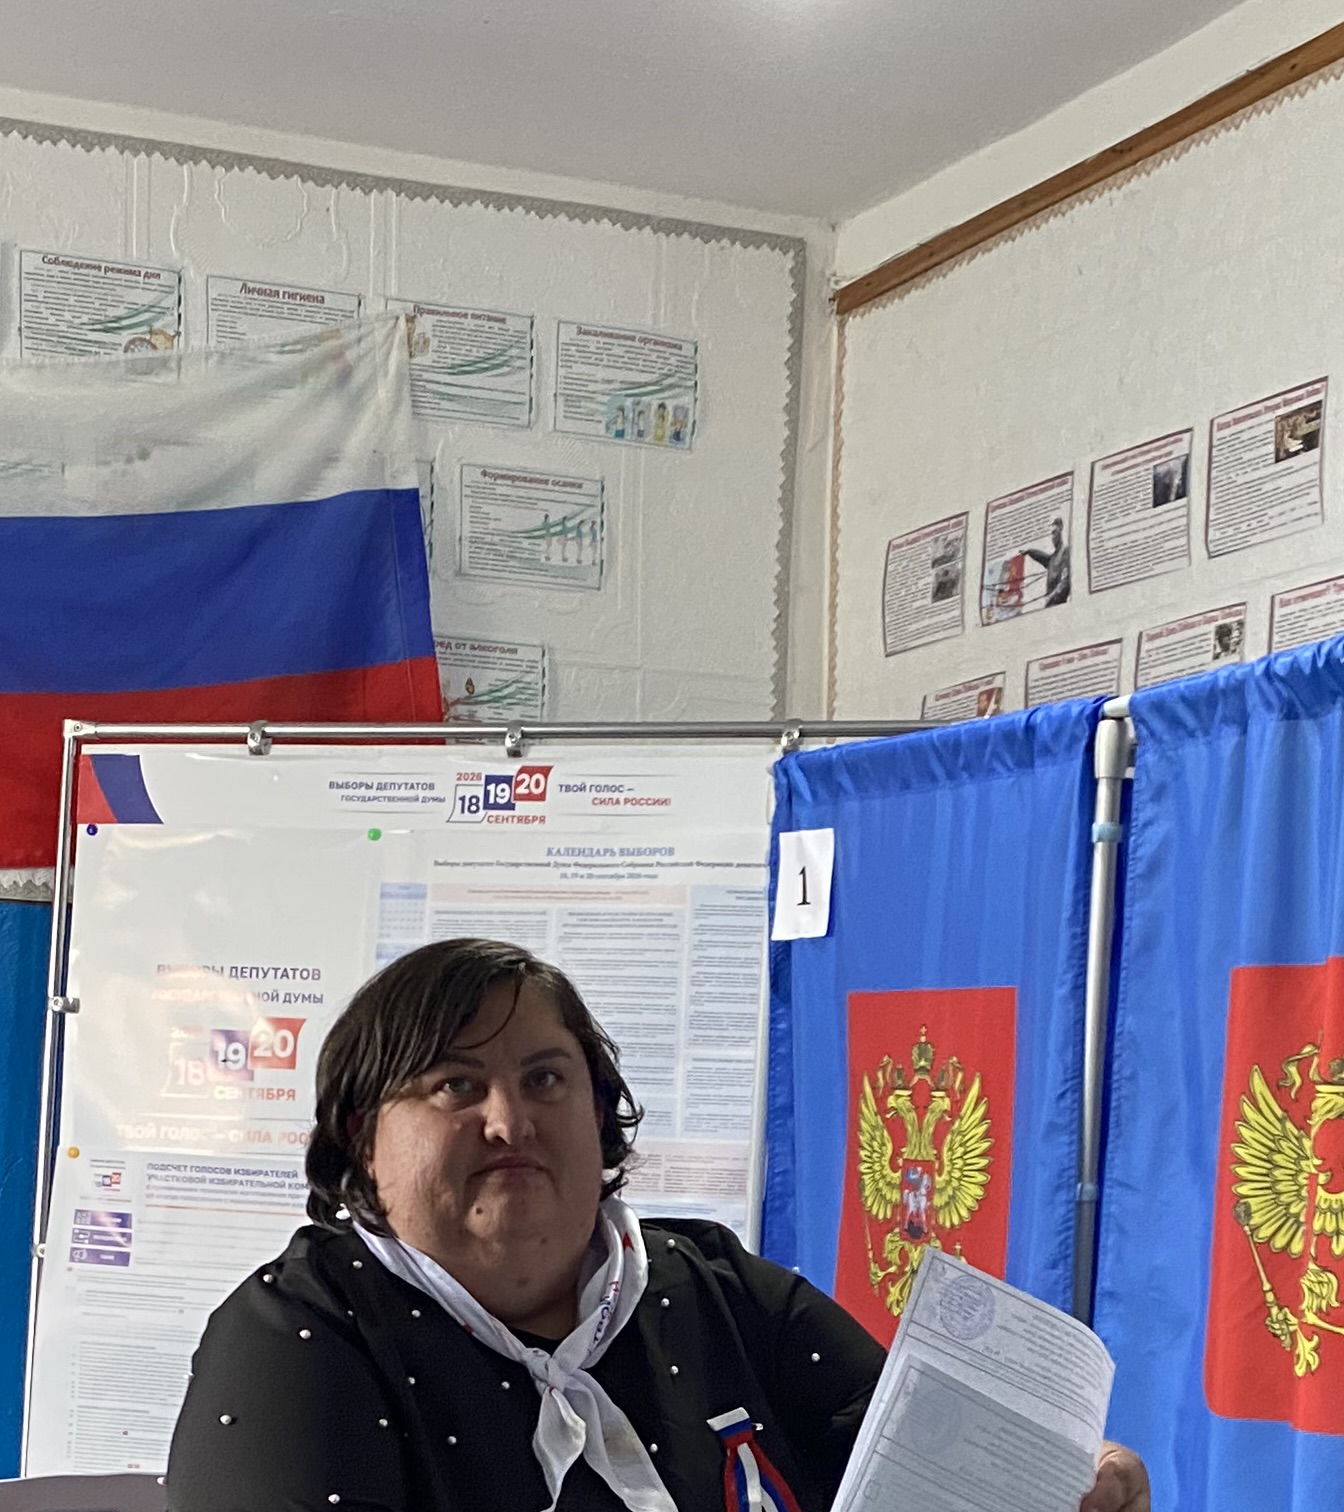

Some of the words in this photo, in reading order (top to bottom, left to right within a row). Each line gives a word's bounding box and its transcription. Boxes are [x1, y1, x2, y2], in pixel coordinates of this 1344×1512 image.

[328, 780, 374, 790] ВЫБОРЫ
[375, 781, 436, 792] ДЕПУТАТОВ
[515, 772, 546, 794] 20
[558, 782, 587, 793] ТВОЙ
[589, 784, 625, 793] ГОЛОС
[486, 782, 511, 804] 19
[458, 794, 481, 815] 18
[591, 797, 621, 806] СИЛА
[486, 814, 546, 825] СЕНТЯБРЯ
[545, 847, 616, 857] КАЛЕНДАРЬ
[618, 846, 675, 857] ВЫБОРОВ
[797, 866, 811, 906] 1
[229, 965, 321, 981] ДЕПУТАТОВ
[282, 992, 324, 1004] ДУМЫ
[253, 1029, 295, 1058] 20
[216, 1042, 247, 1070] 19
[174, 1058, 204, 1086] 18
[288, 1182, 312, 1191] КОМ
